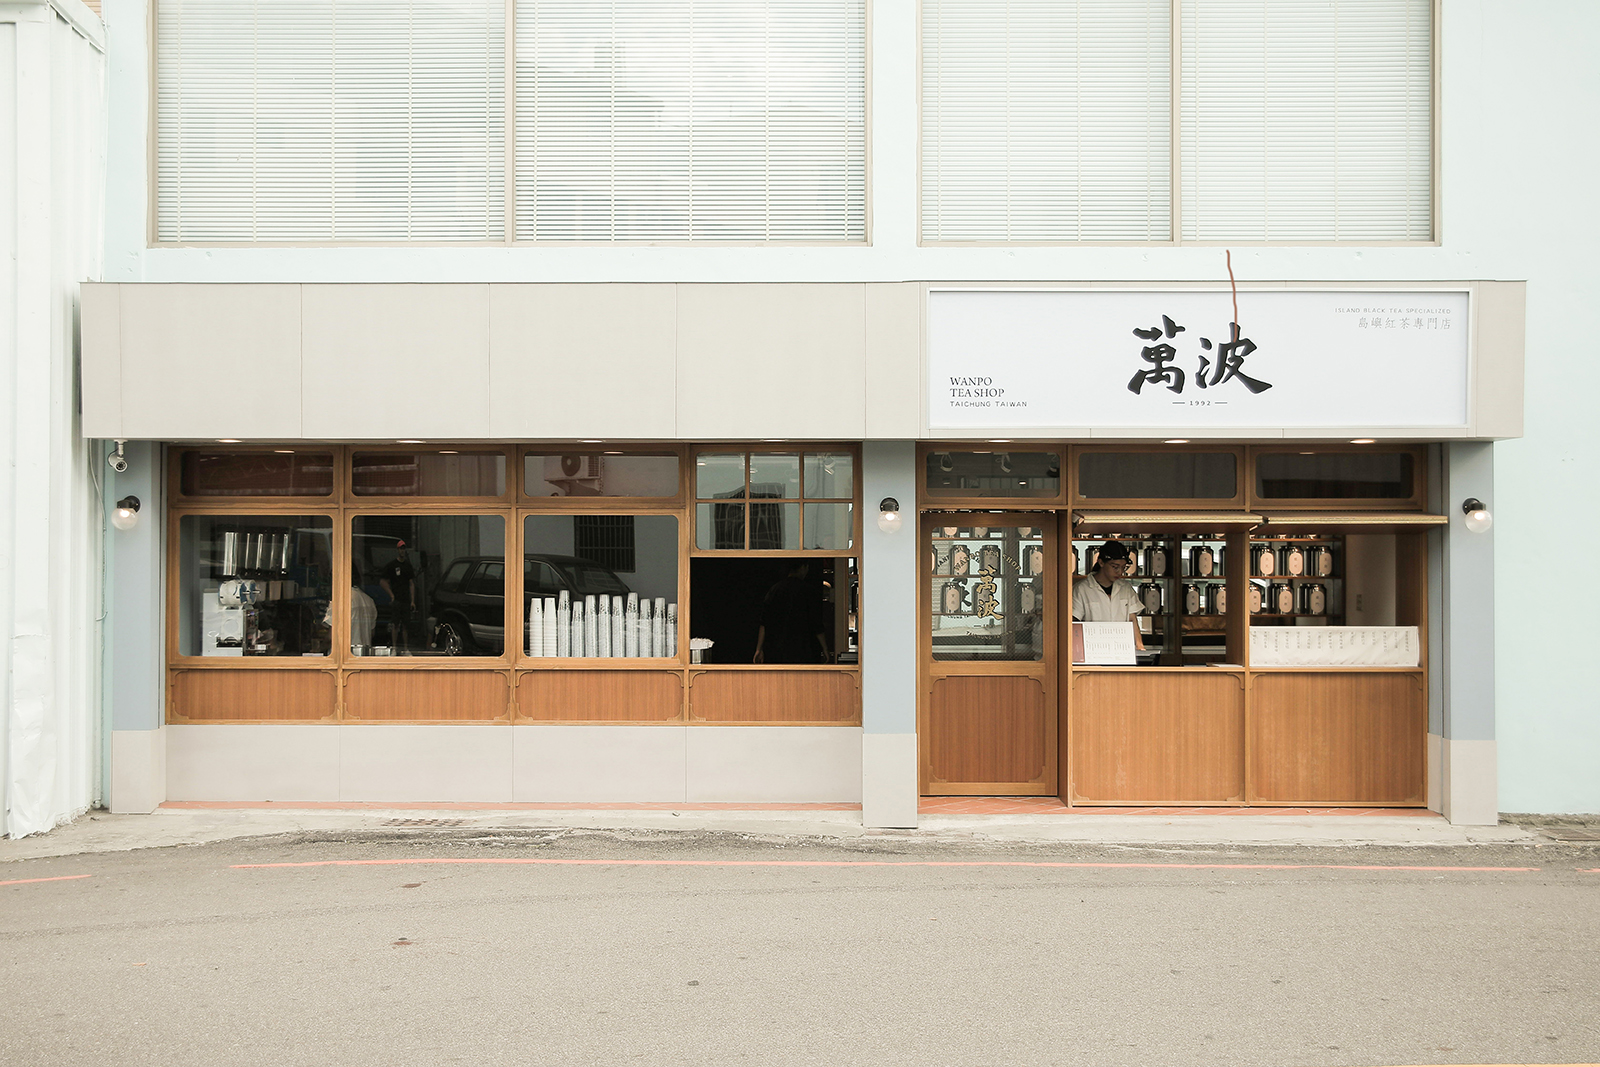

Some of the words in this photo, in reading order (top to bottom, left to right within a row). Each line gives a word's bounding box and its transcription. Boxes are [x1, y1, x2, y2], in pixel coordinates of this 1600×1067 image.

[1358, 317, 1451, 329] 島嶼紅茶專門店
[1127, 314, 1273, 395] 萬波
[950, 377, 992, 386] WANPO
[950, 388, 972, 398] TEA
[974, 388, 1005, 398] SHOP
[1002, 554, 1022, 571] SHOP
[976, 565, 1005, 620] 萬波
